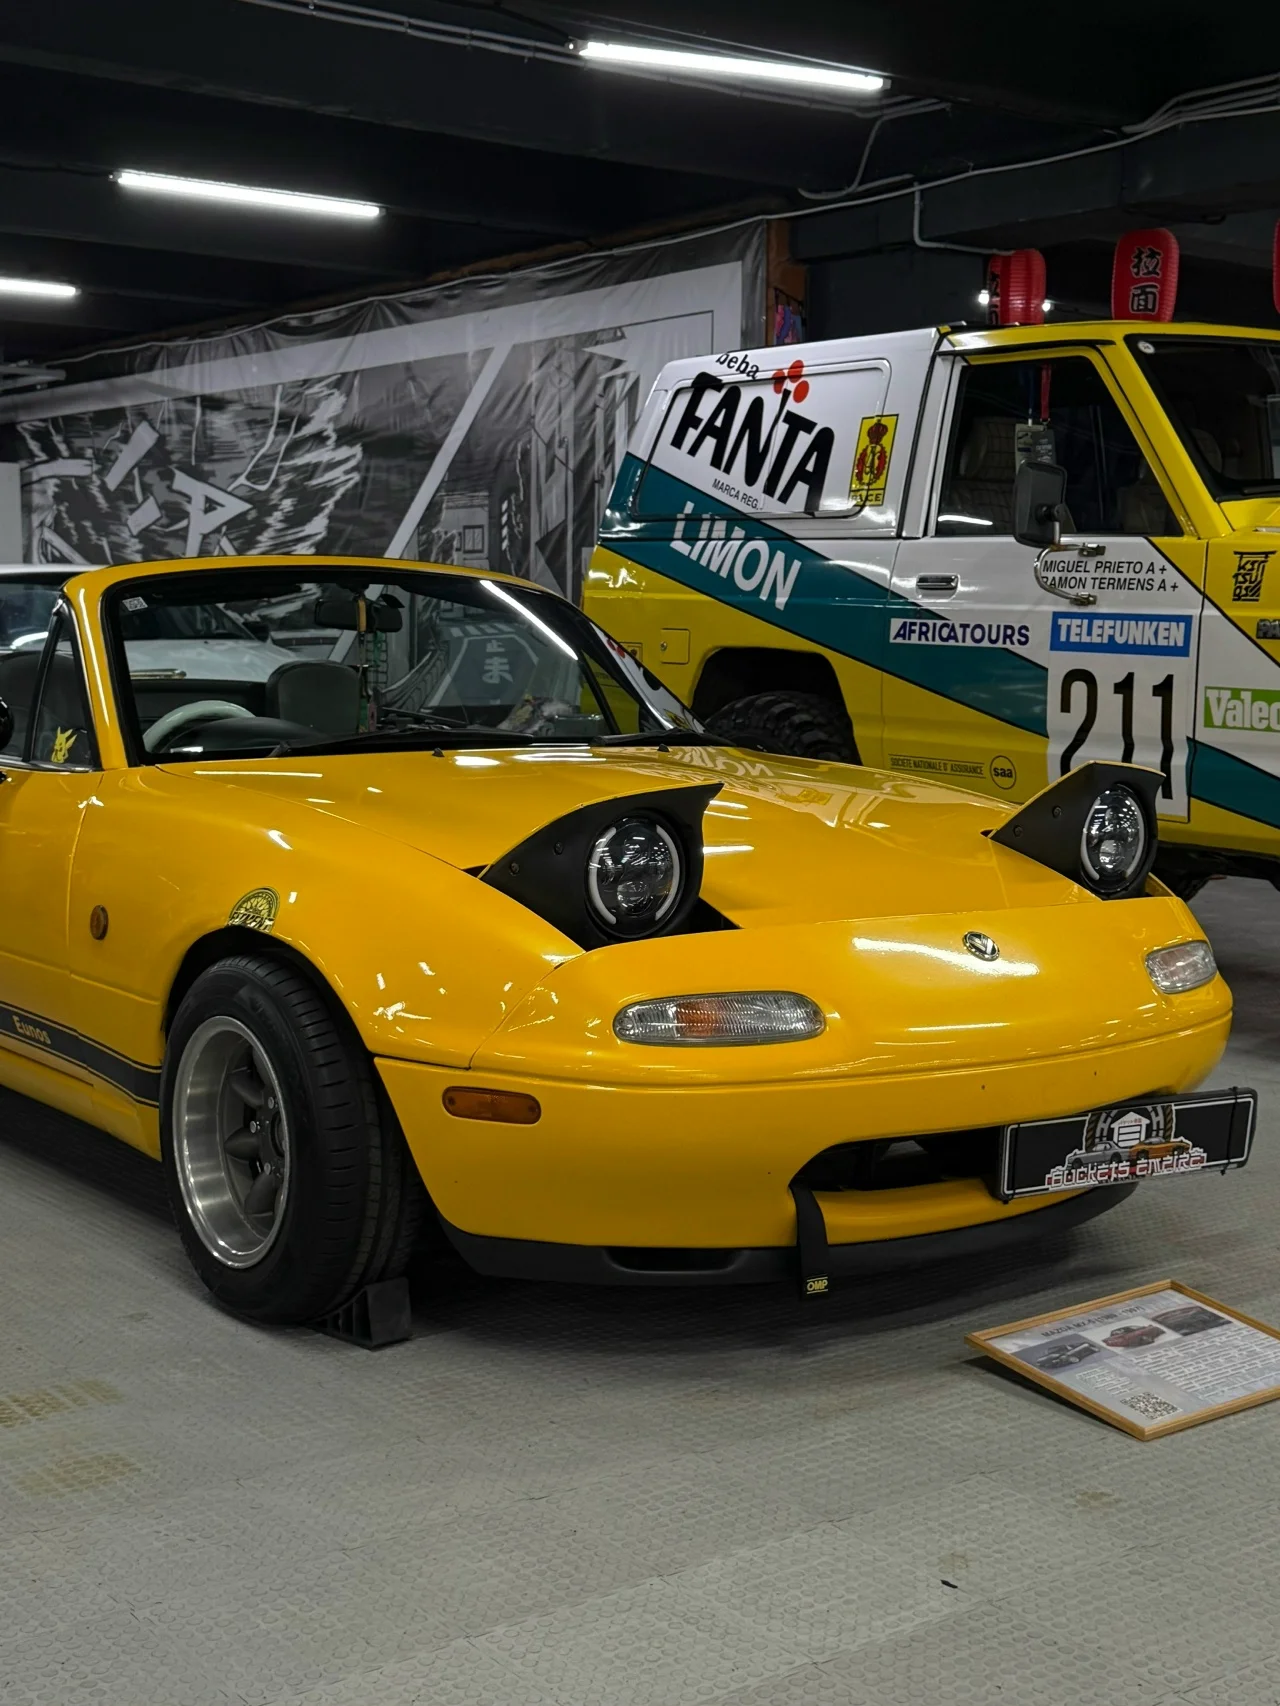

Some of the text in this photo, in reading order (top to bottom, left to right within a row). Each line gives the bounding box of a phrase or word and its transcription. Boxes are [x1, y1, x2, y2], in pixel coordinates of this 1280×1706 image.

[1130, 247, 1161, 314] 拉面
[670, 372, 835, 517] FANTA
[712, 478, 740, 500] MARCA
[669, 501, 802, 611] LIMON
[1042, 560, 1090, 573] MIGUEL
[1094, 561, 1143, 574] PRIETO
[1145, 562, 1155, 575] A
[1091, 577, 1155, 592] TERMENS
[1157, 579, 1167, 592] A
[892, 620, 1030, 646] AFRICATOURS
[1057, 617, 1186, 647] TELEFUNKEN
[1059, 668, 1174, 800] 211
[913, 759, 942, 771] NATIONALE
[950, 763, 984, 776] ASSURANCE
[993, 767, 1013, 778] saa
[12, 1015, 51, 1044] Eunos
[807, 1279, 828, 1291] OMP
